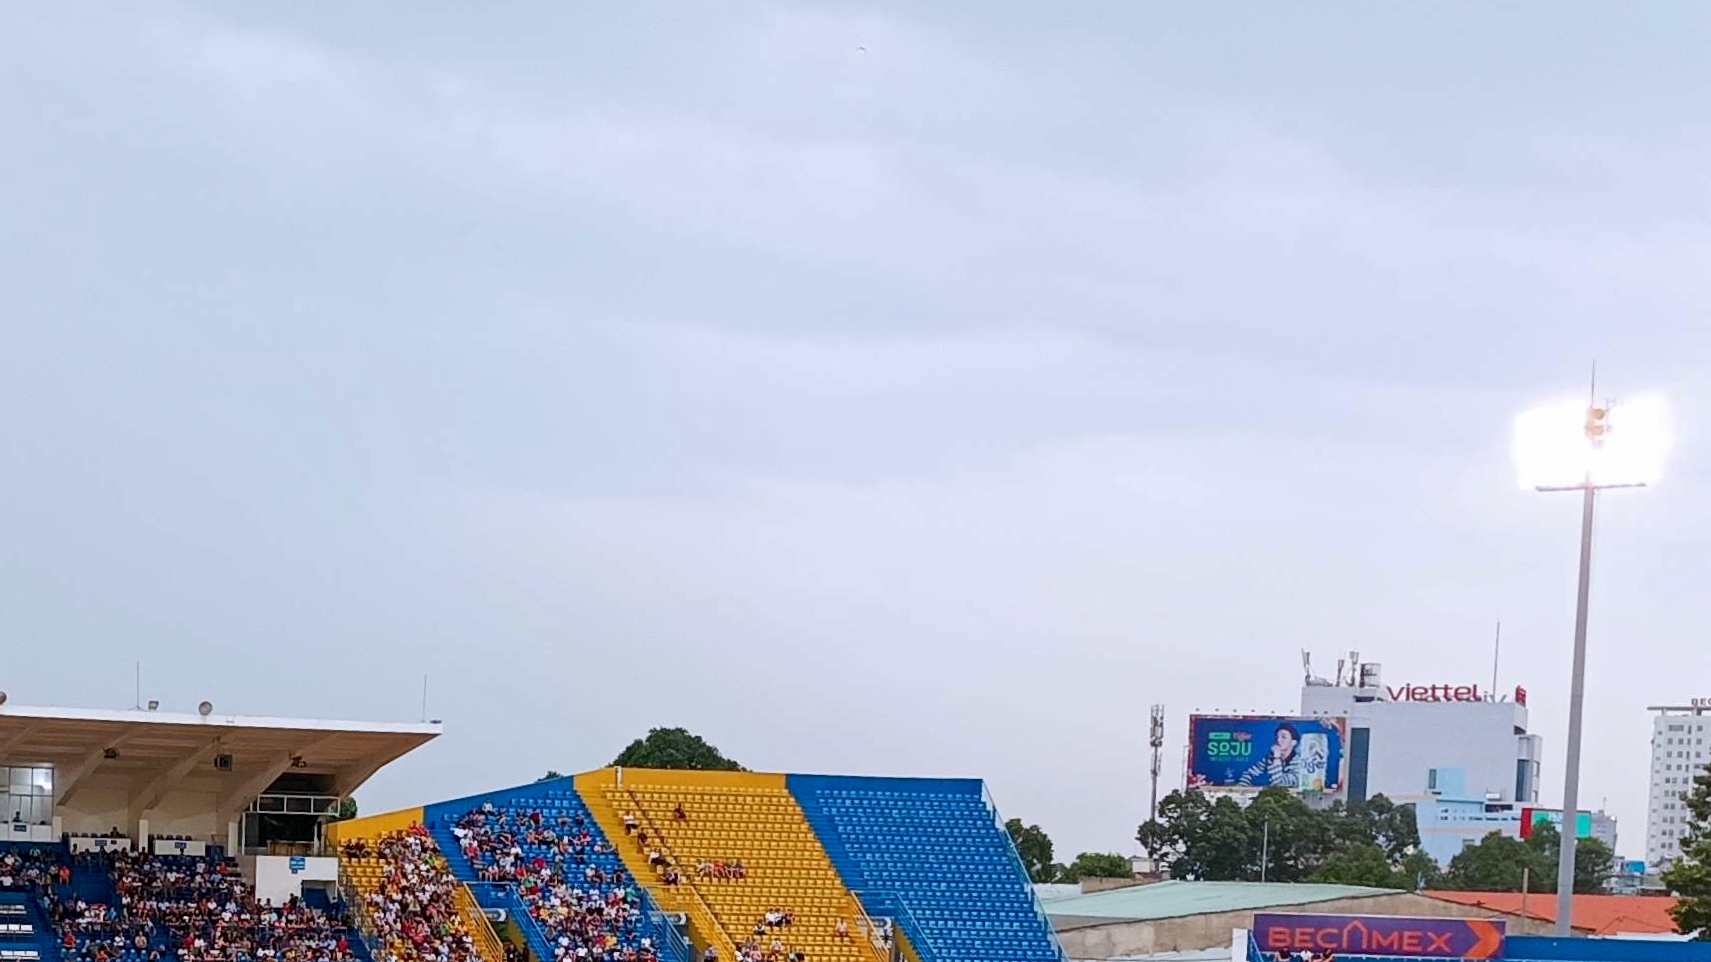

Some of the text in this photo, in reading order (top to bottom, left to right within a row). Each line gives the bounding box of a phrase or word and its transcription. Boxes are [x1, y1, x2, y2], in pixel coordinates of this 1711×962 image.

[1386, 683, 1483, 702] viettel
[1207, 741, 1252, 756] SOJU
[1268, 919, 1452, 952] BECAMEX
